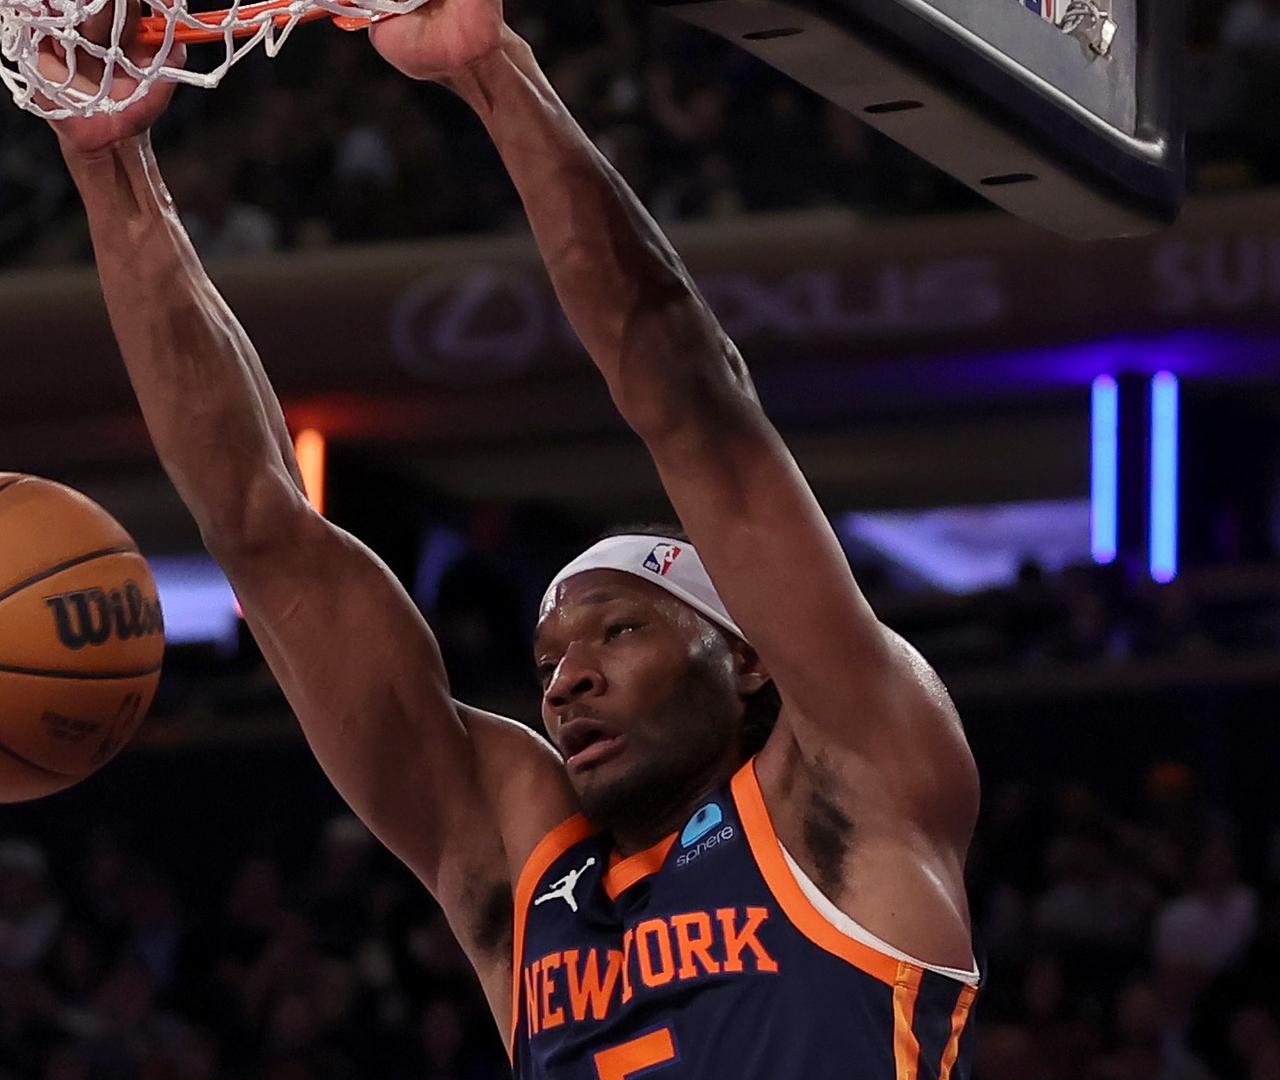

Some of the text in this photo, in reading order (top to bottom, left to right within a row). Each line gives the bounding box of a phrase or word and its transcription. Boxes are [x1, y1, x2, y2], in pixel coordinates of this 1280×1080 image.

[676, 825, 734, 868] sphere
[524, 906, 781, 1040] NEW YORK
